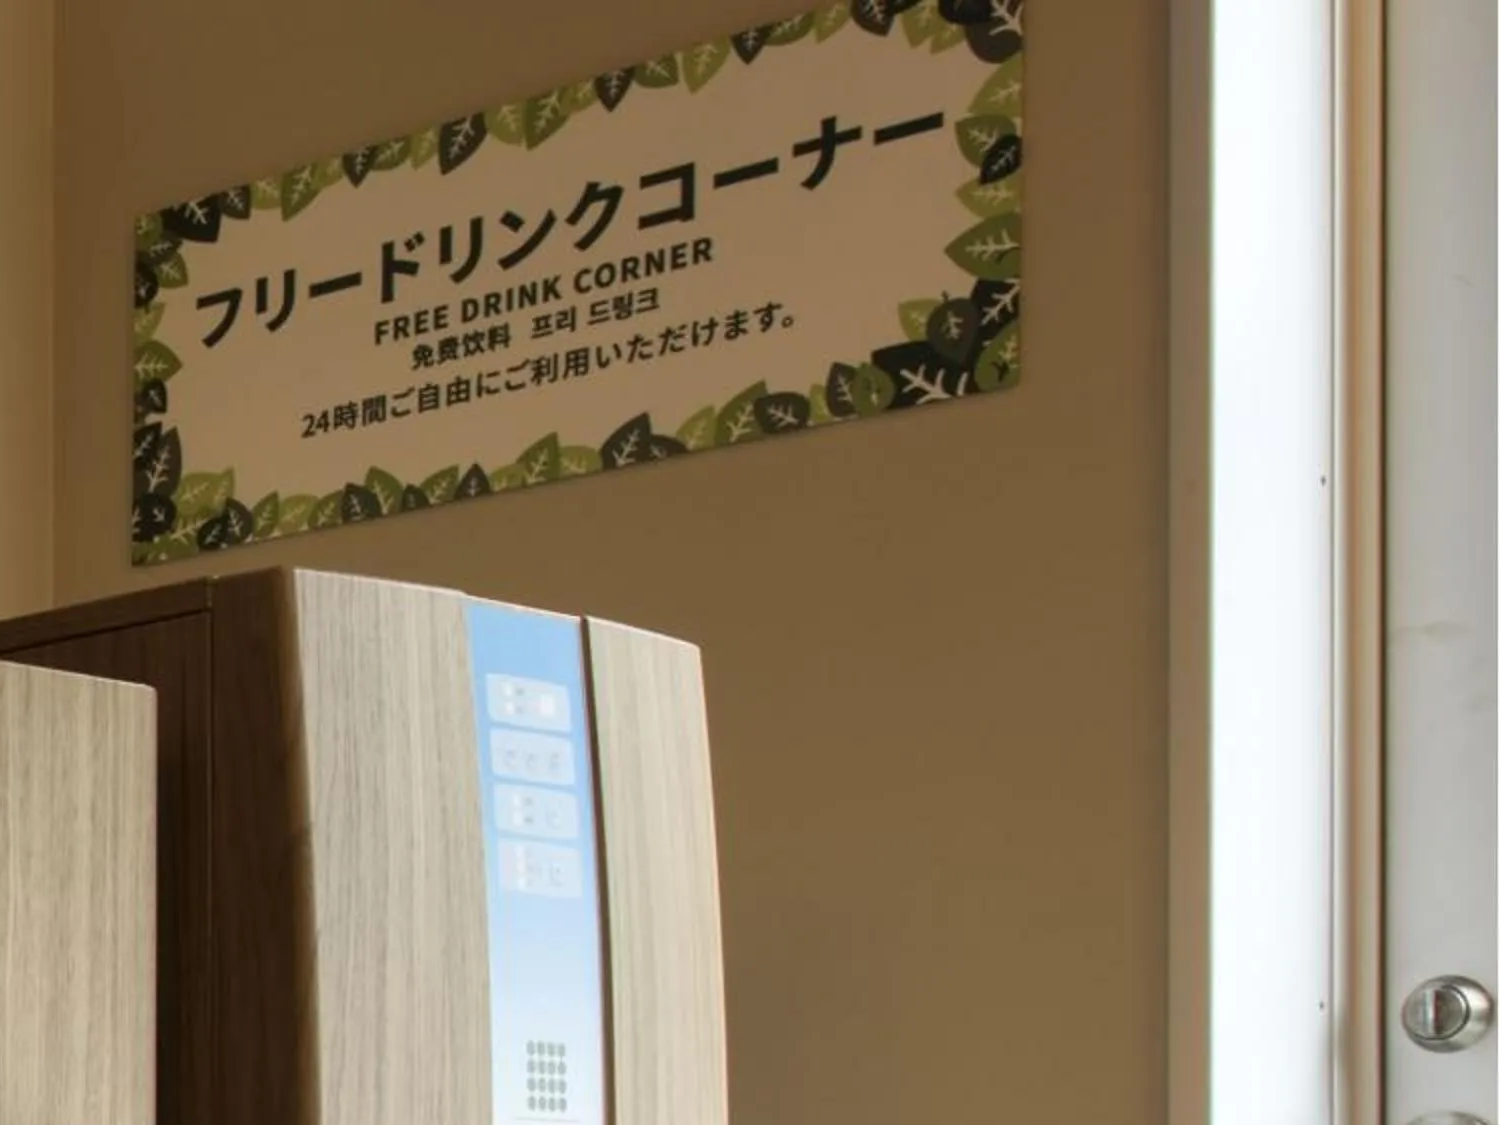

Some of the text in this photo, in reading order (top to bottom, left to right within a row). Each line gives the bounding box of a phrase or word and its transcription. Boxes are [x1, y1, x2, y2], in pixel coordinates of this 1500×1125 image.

[195, 111, 945, 347] フリードリンクコーナー
[374, 237, 714, 346] FREE DRINK CORNER
[531, 287, 661, 340] 프리 드링크
[301, 301, 796, 439] 24時間ご自由にご利用いただけます。
[411, 323, 512, 370] 免费饮料
